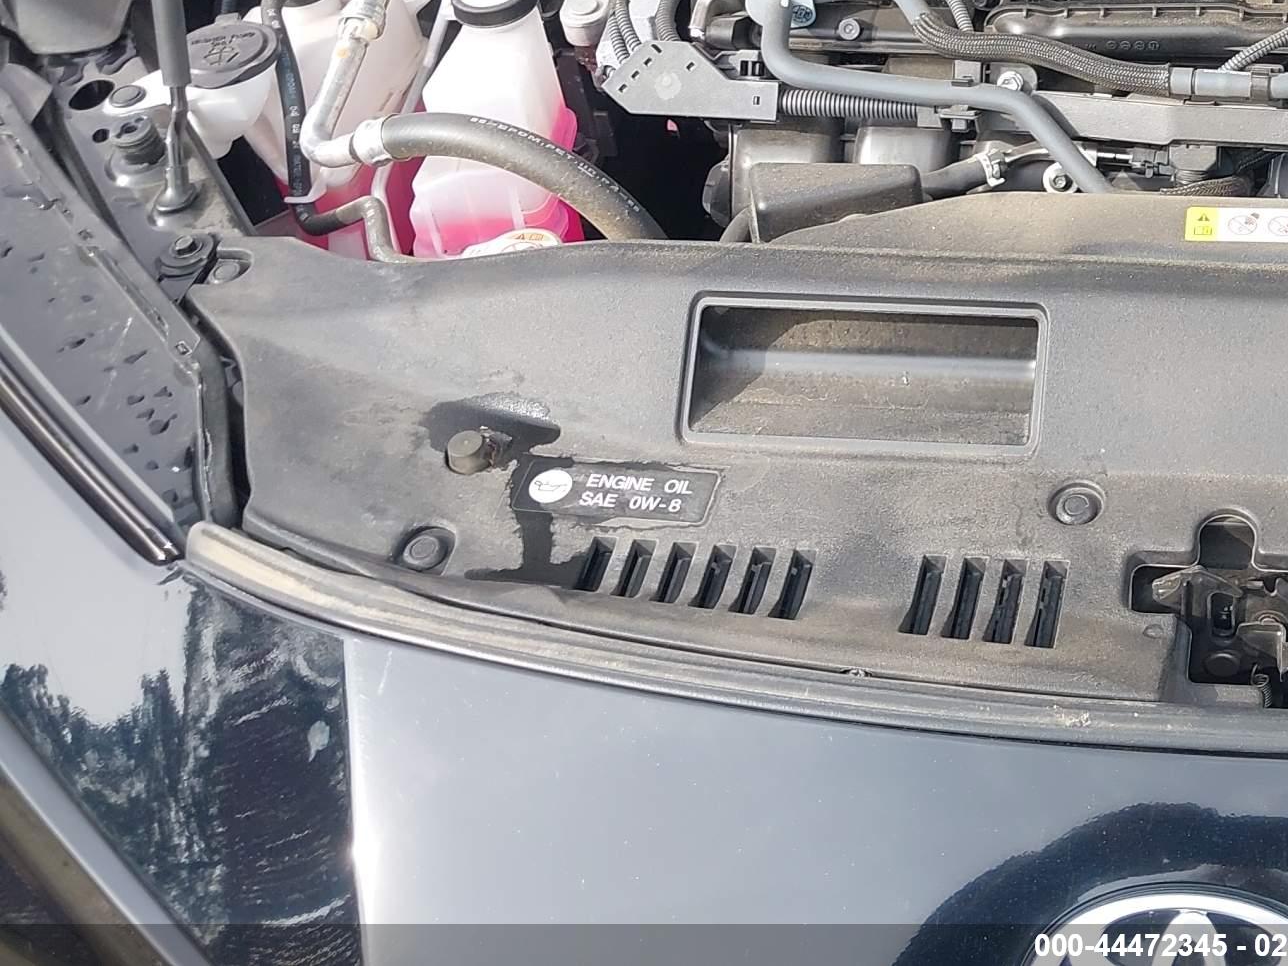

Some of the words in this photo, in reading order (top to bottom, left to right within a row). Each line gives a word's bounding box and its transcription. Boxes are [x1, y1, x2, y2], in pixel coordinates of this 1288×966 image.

[586, 474, 654, 491] ENGINE
[664, 479, 693, 494] OIL
[579, 491, 618, 508] SAE
[629, 496, 682, 512] 0W-8
